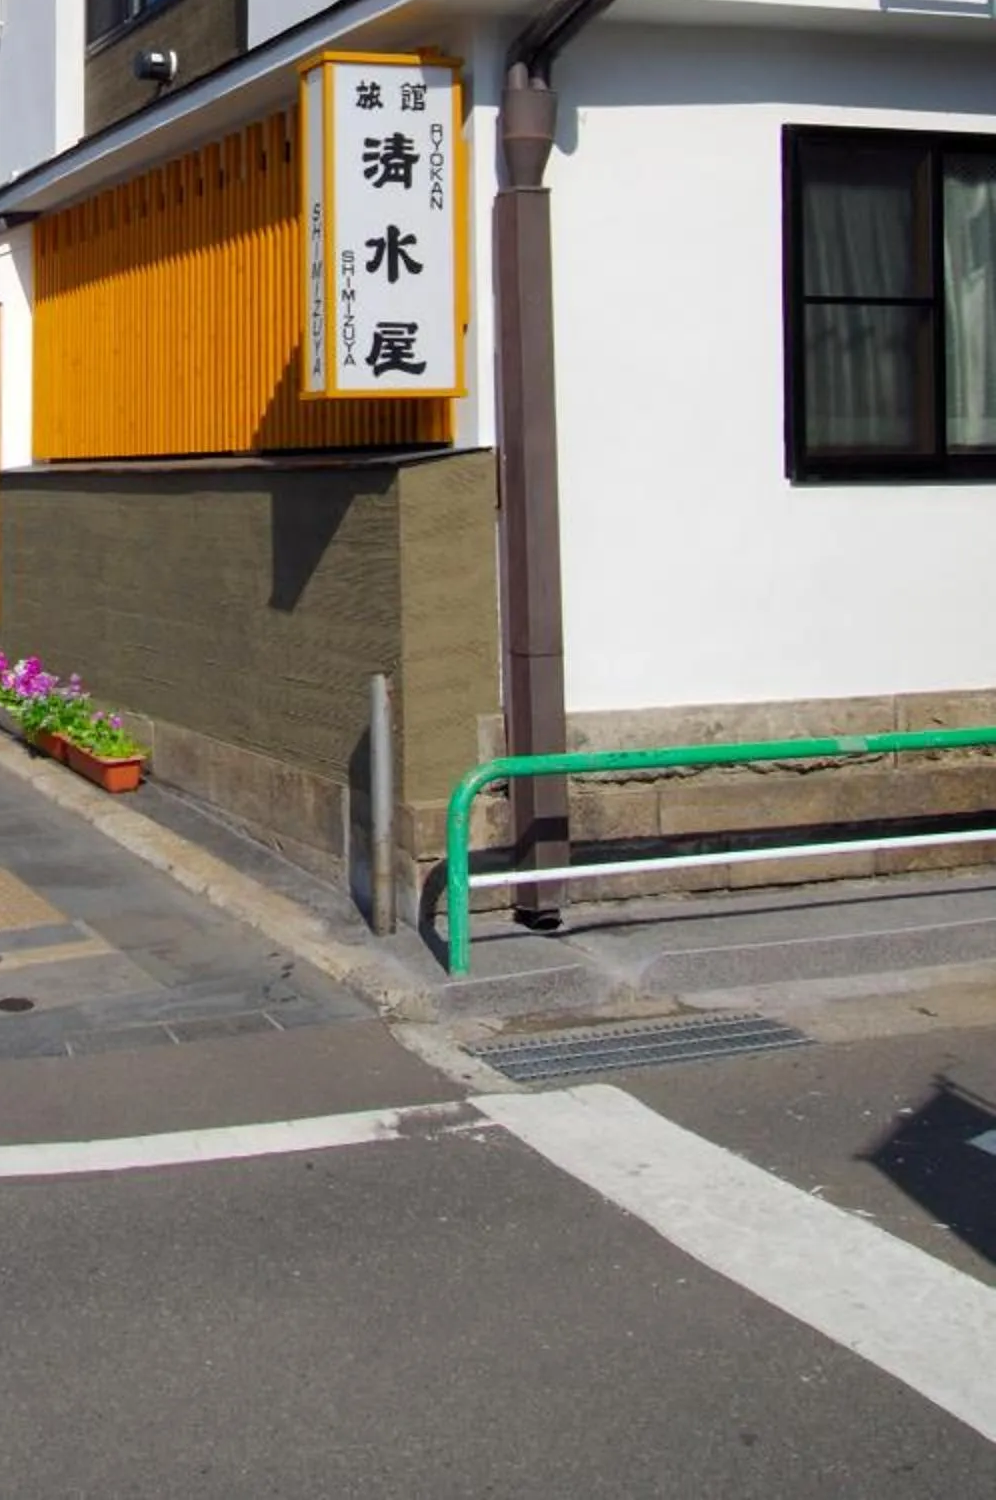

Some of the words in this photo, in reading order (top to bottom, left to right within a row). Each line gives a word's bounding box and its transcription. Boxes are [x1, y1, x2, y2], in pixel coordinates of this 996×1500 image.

[355, 79, 427, 112] 旅館
[429, 123, 444, 211] RYOKAN
[311, 202, 322, 376] SHIMIZUYA
[341, 250, 356, 367] SHIMIZUYA
[362, 131, 427, 377] 清水屋
